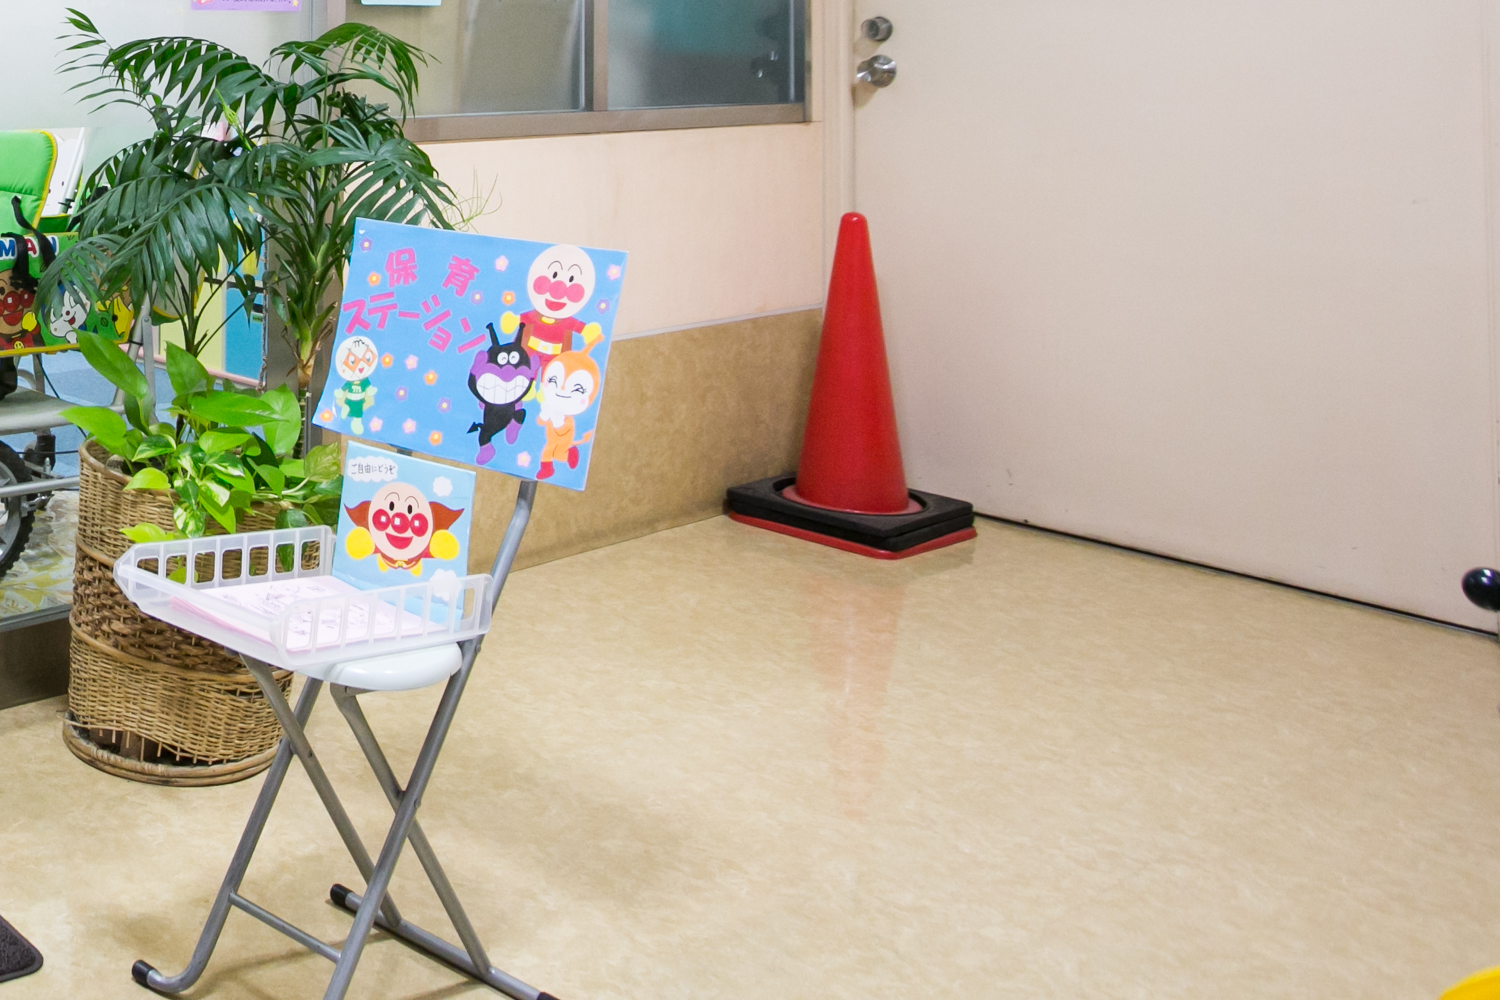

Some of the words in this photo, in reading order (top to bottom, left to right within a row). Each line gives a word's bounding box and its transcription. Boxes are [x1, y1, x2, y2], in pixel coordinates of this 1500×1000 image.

[385, 247, 481, 298] 保育
[343, 290, 488, 356] ステーション
[351, 462, 396, 475] ご自由にどうぞ
